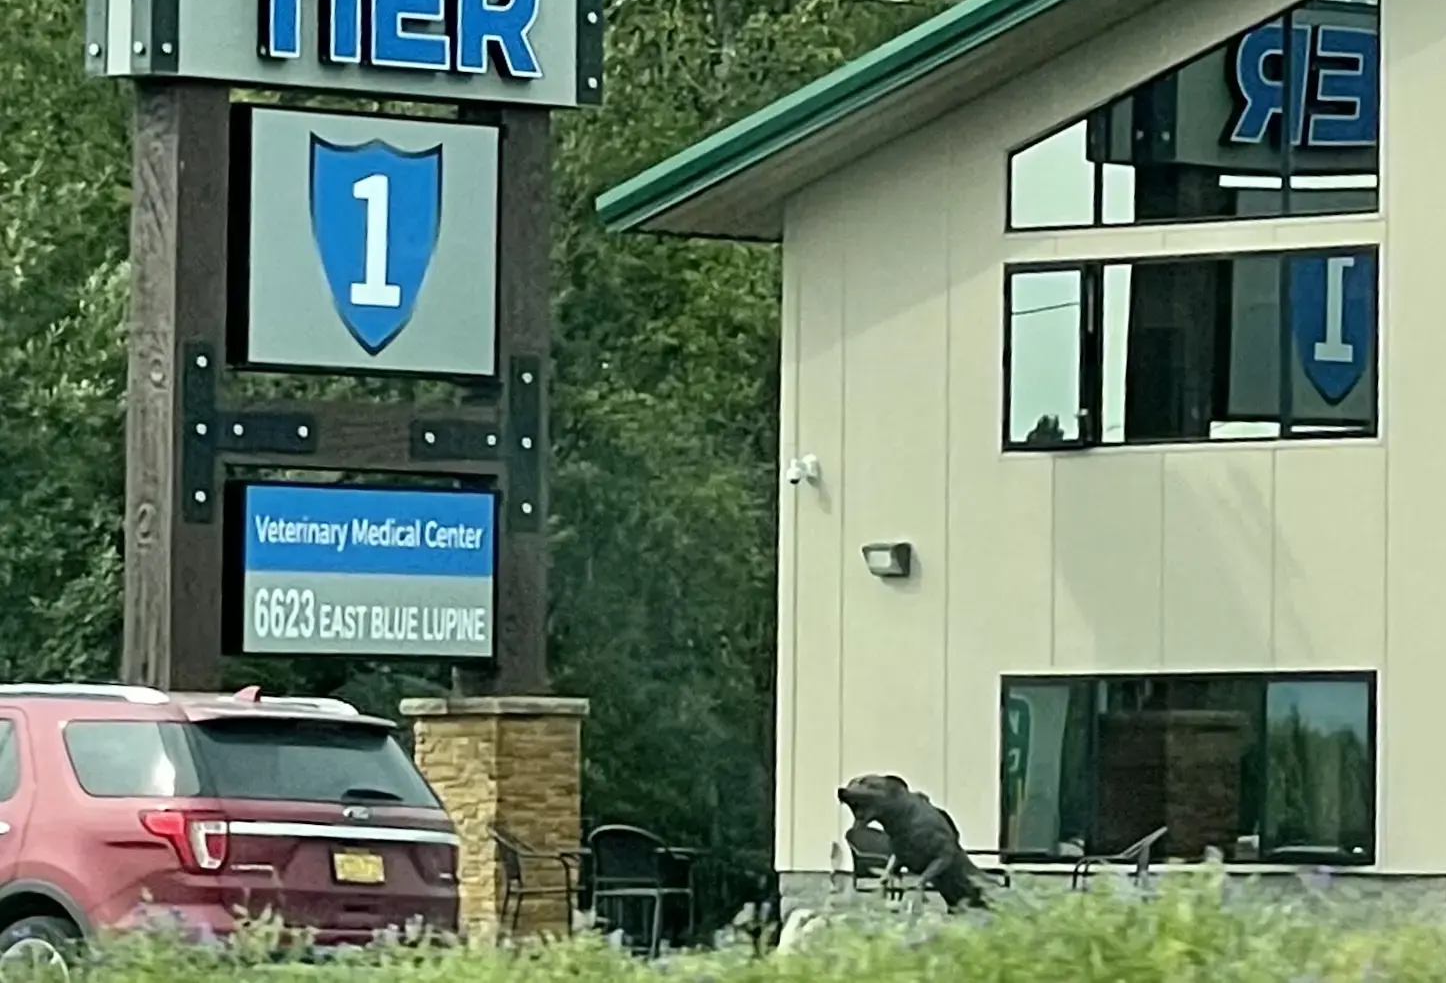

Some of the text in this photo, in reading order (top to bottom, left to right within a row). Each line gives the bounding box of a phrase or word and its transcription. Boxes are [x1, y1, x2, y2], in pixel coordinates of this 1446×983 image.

[349, 173, 401, 308] 1
[254, 514, 484, 553] Veterinary Medical Center
[254, 587, 486, 642] 6623 EAST BLUE LUPINE
